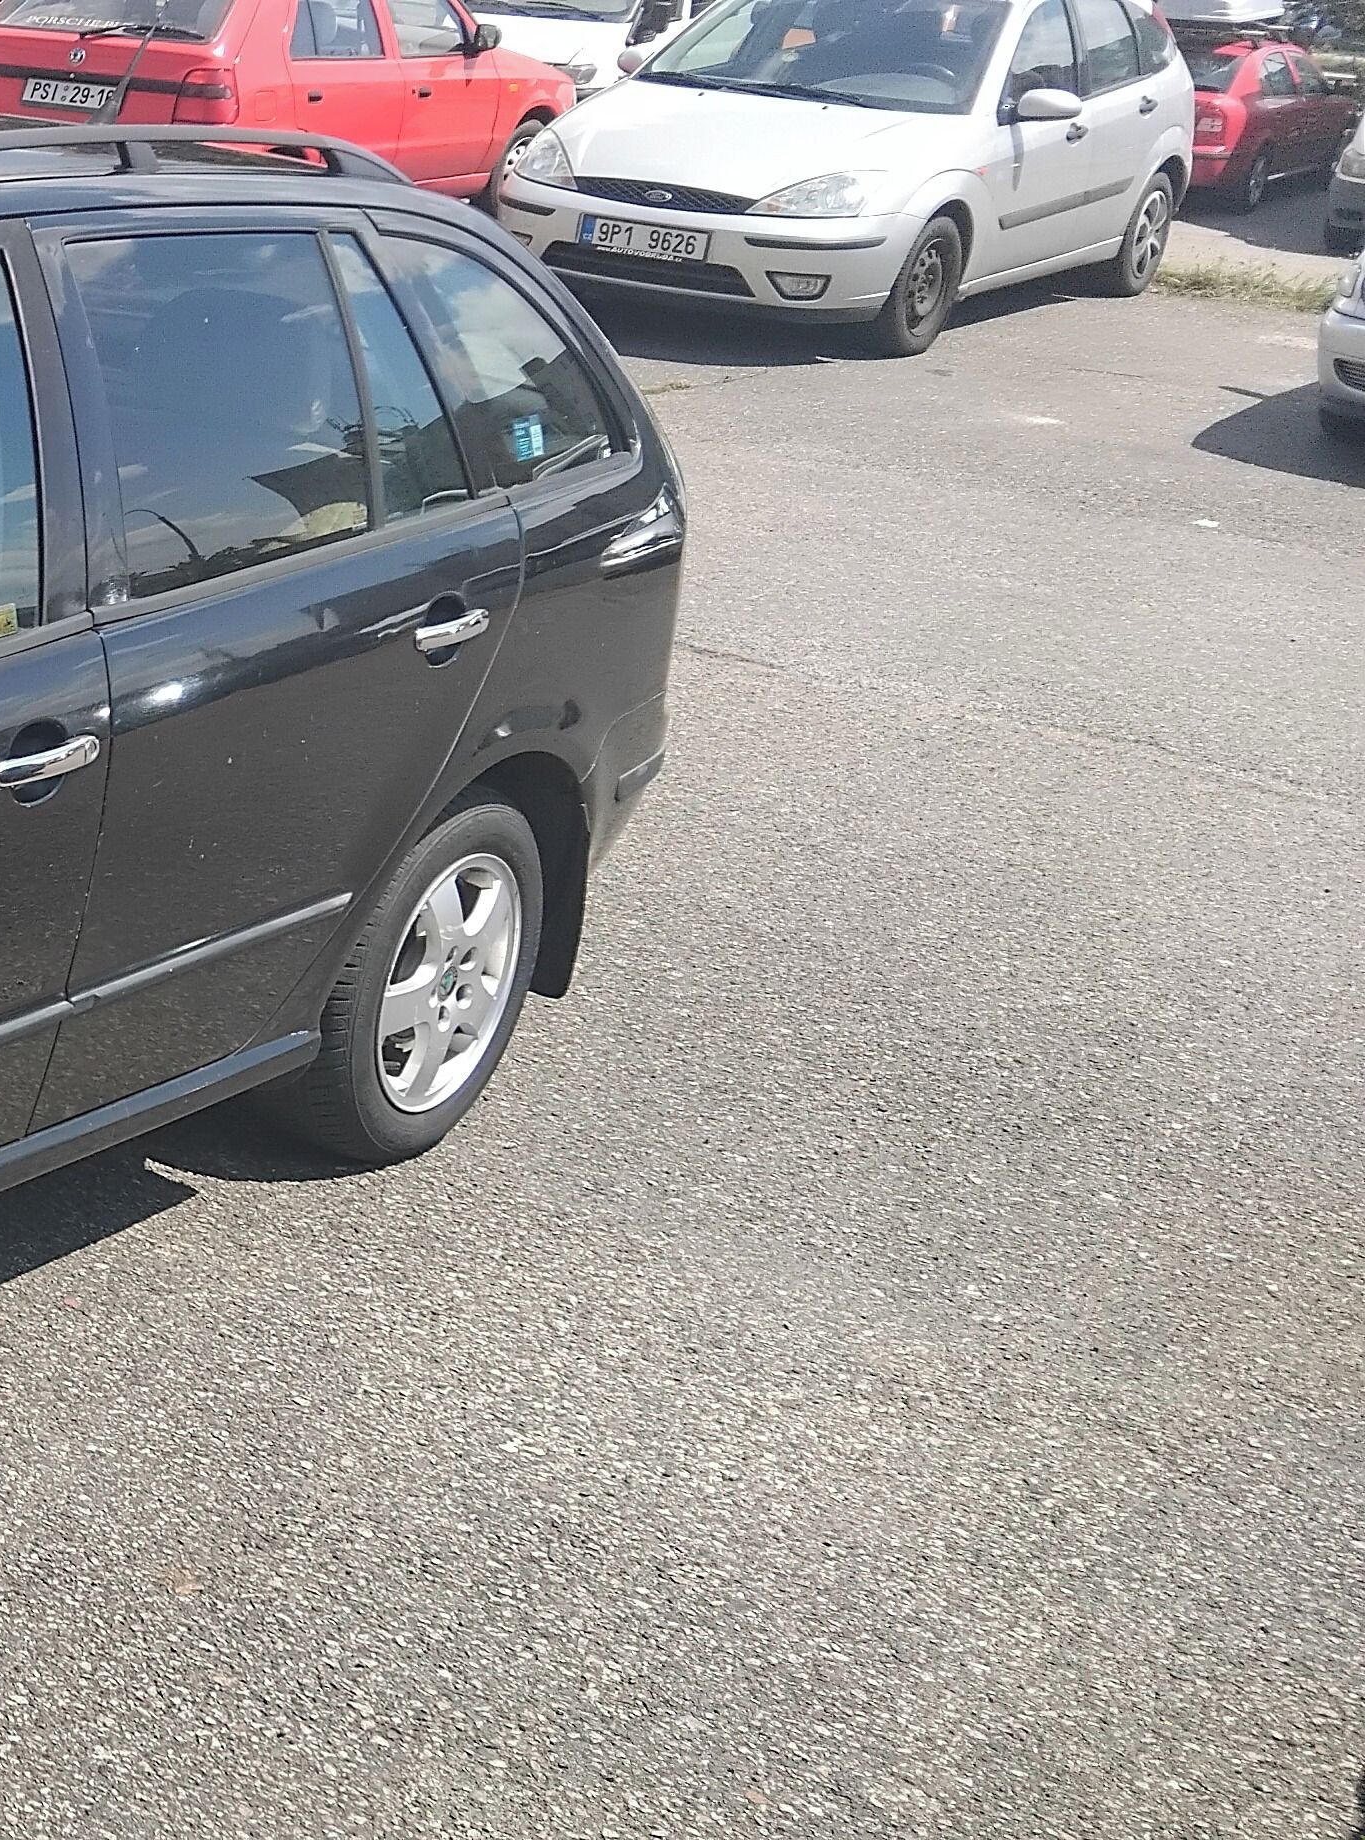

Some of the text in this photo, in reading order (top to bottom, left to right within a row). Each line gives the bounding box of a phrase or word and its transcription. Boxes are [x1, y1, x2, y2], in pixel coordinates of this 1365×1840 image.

[29, 82, 59, 101] PSI
[597, 222, 697, 255] 9P1 9626
